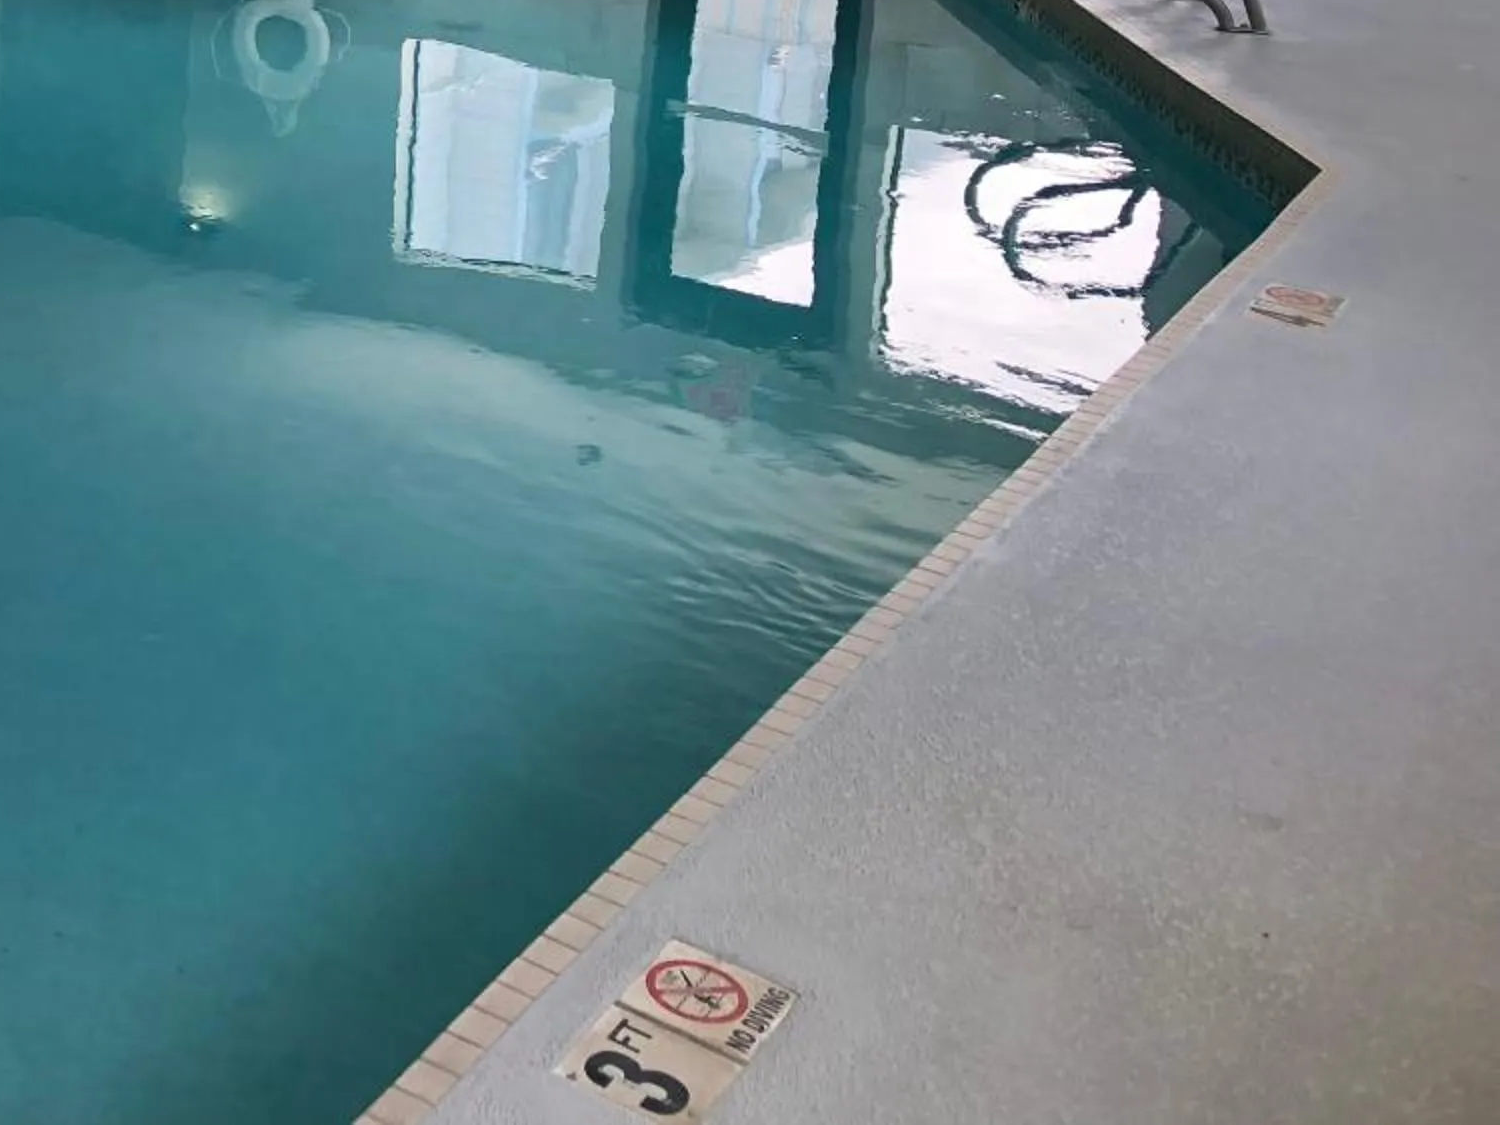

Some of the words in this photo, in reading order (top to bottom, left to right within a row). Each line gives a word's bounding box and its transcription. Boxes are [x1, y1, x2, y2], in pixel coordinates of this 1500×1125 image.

[607, 1017, 653, 1055] FT
[725, 1029, 757, 1054] NO
[741, 987, 790, 1034] DIVING
[583, 1050, 691, 1116] 3
